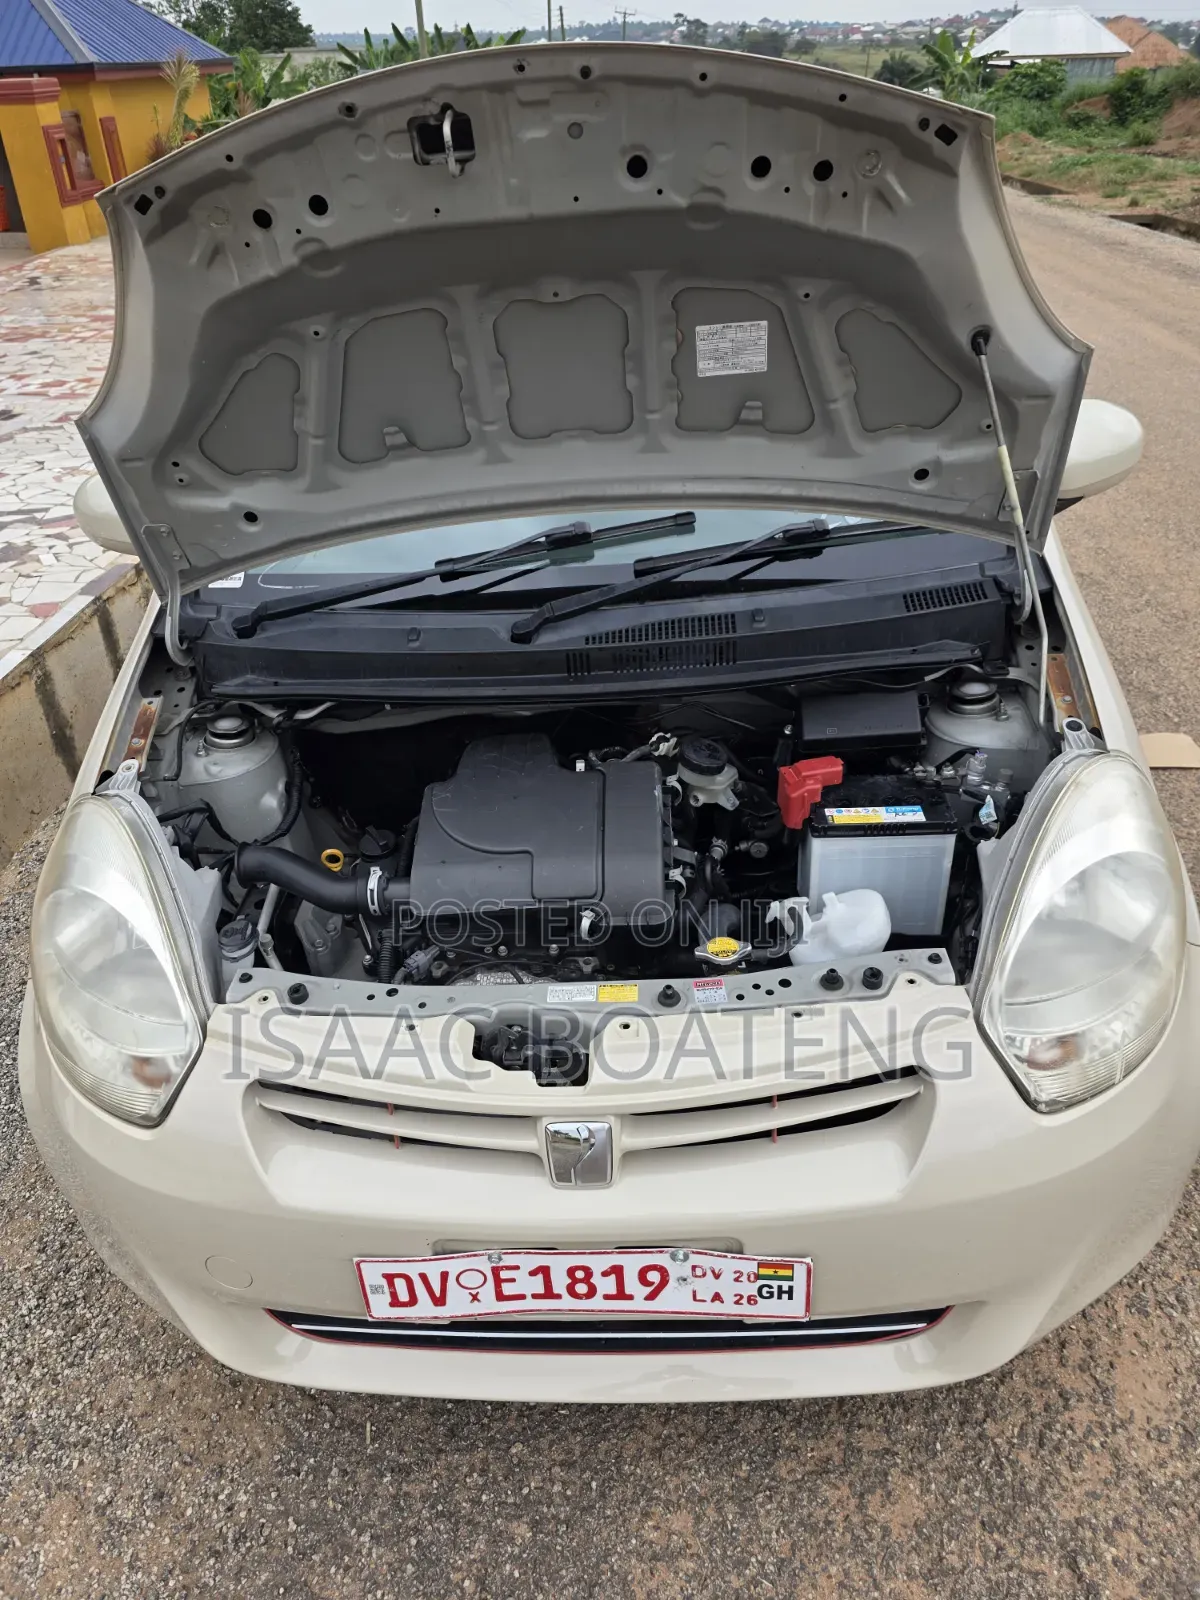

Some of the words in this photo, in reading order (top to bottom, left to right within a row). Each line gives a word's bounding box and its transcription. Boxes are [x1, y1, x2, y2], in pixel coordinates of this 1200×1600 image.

[691, 1264, 724, 1280] DV
[733, 1270, 758, 1283] 20
[381, 1270, 449, 1308] DV
[491, 1264, 670, 1302] E1819
[757, 1284, 794, 1300] GH
[691, 1288, 725, 1304] LA
[733, 1293, 758, 1306] 26
